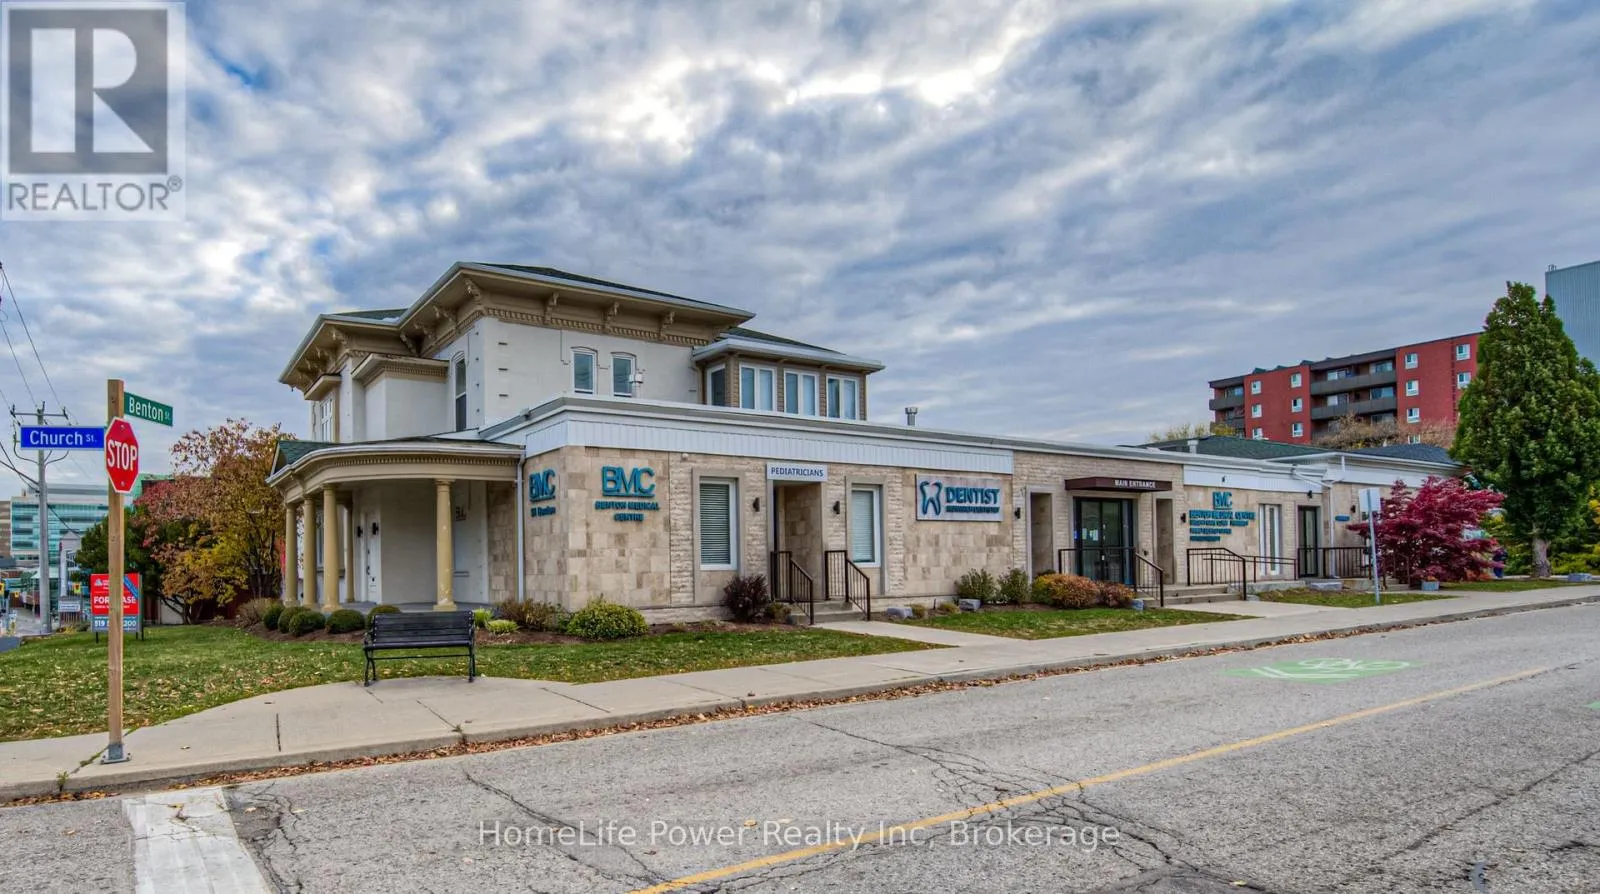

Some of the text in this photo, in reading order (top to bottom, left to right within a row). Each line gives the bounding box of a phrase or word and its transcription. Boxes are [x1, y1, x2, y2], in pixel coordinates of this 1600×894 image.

[128, 396, 164, 422] Benton
[29, 430, 83, 446] Church
[107, 439, 138, 472] STOP
[602, 466, 655, 494] BMC
[771, 467, 824, 477] PEDIATRICIANS
[529, 469, 556, 500] BMC
[1115, 479, 1156, 489] MAIN ENTRANCE
[946, 487, 1000, 504] DENTIST
[1213, 491, 1233, 508] BMC
[595, 500, 659, 511] BENTON MEDICAL
